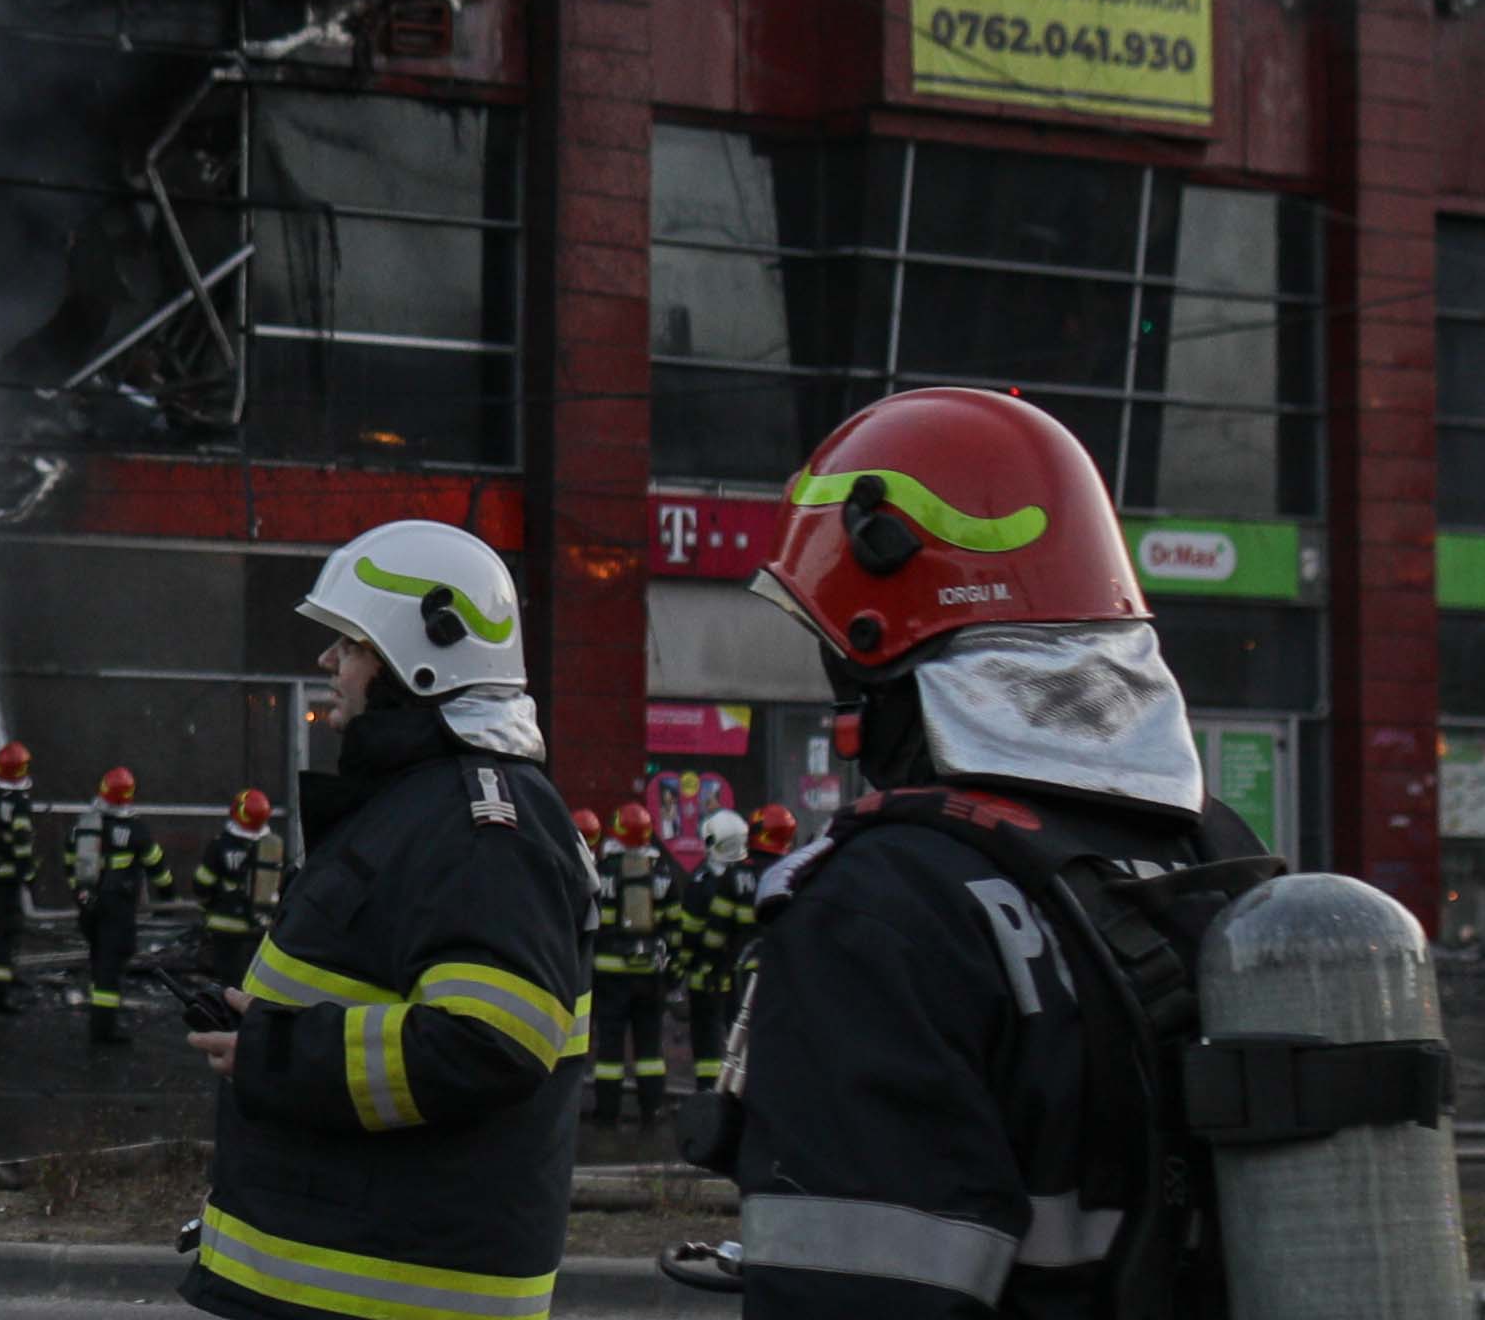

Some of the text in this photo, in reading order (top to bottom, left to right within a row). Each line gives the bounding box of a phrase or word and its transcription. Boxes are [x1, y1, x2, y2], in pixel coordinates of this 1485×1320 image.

[932, 7, 1196, 72] 0762.041.930
[659, 505, 698, 564] T
[937, 585, 989, 606] IORGU
